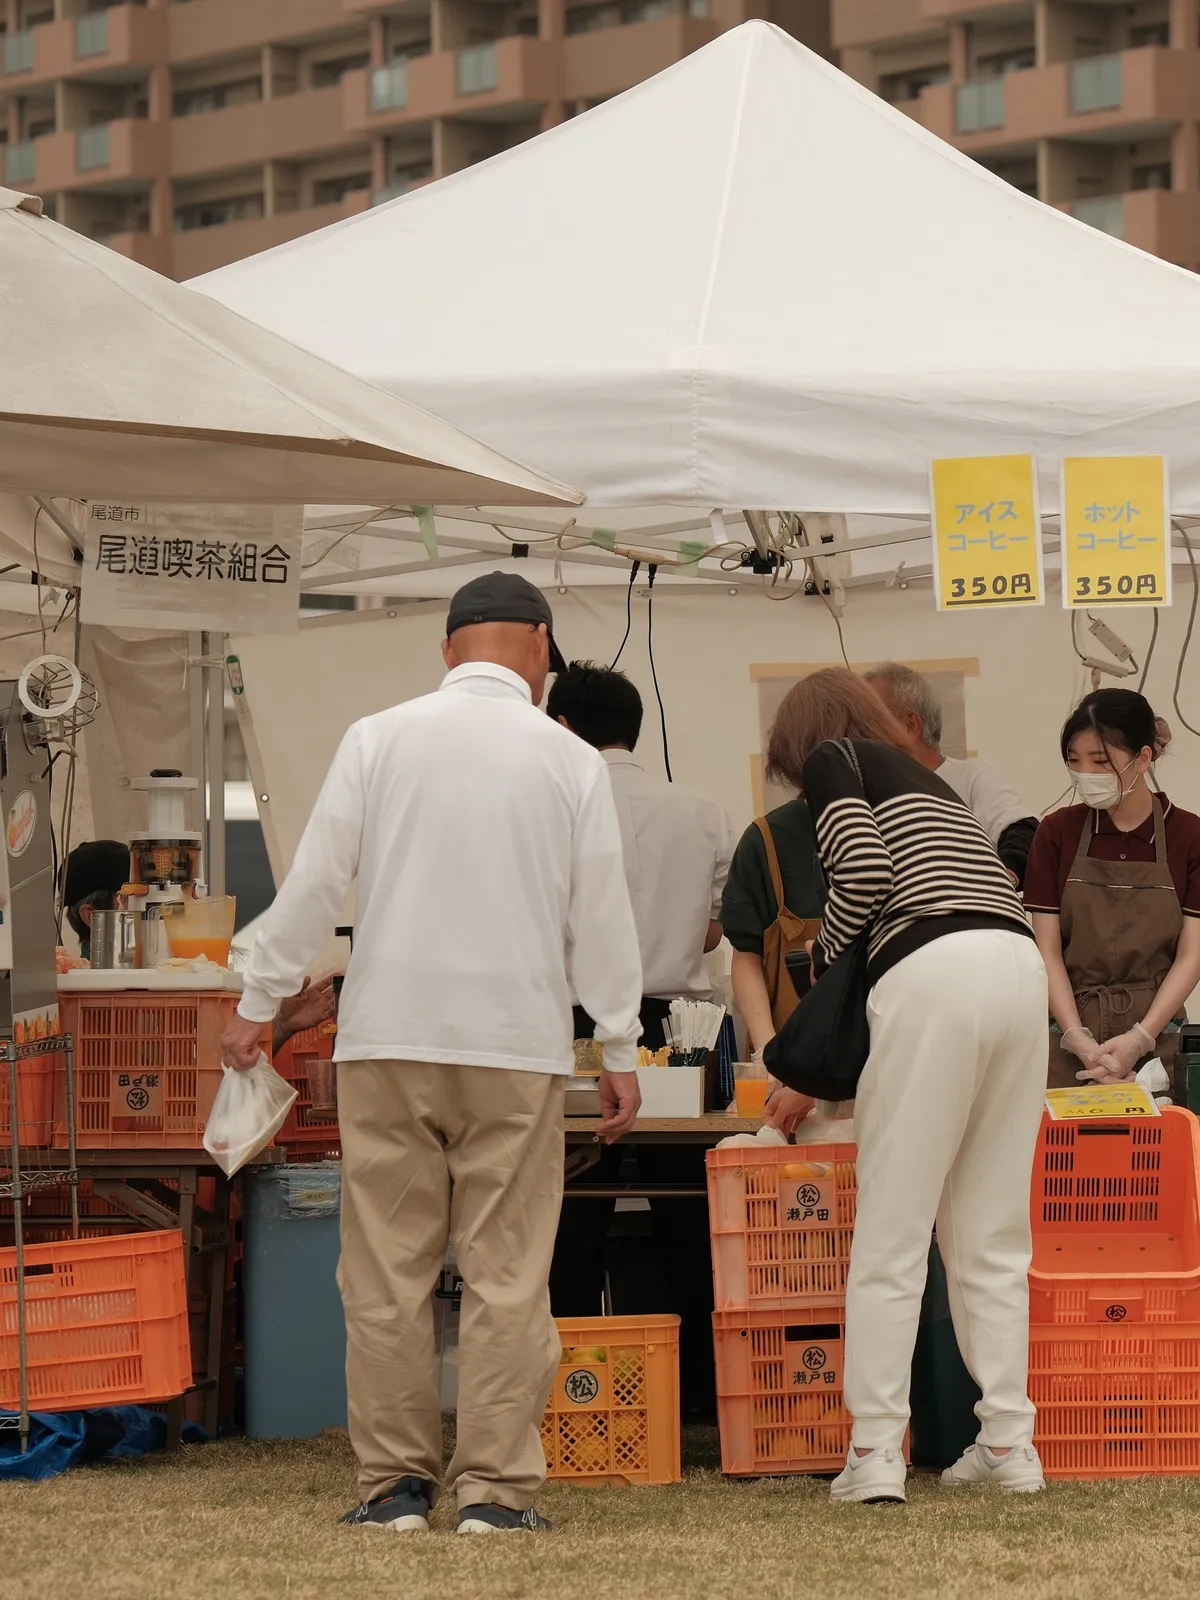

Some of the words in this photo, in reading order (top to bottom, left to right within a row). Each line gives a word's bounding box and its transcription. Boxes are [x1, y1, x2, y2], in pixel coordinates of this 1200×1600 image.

[91, 504, 140, 521] 尾道市
[954, 500, 1018, 524] アイス
[1084, 500, 1140, 523] ホット
[948, 530, 1028, 551] コーヒー
[1077, 530, 1157, 550] コーヒー
[95, 534, 291, 584] 尾道喫茶組合
[951, 573, 1031, 597] 350円
[1076, 574, 1156, 595] 350円
[799, 1186, 818, 1205] 松
[787, 1208, 829, 1221] 瀬戸田
[805, 1349, 824, 1368] 松
[568, 1373, 595, 1400] 松
[793, 1370, 836, 1384] 瀬戸田
